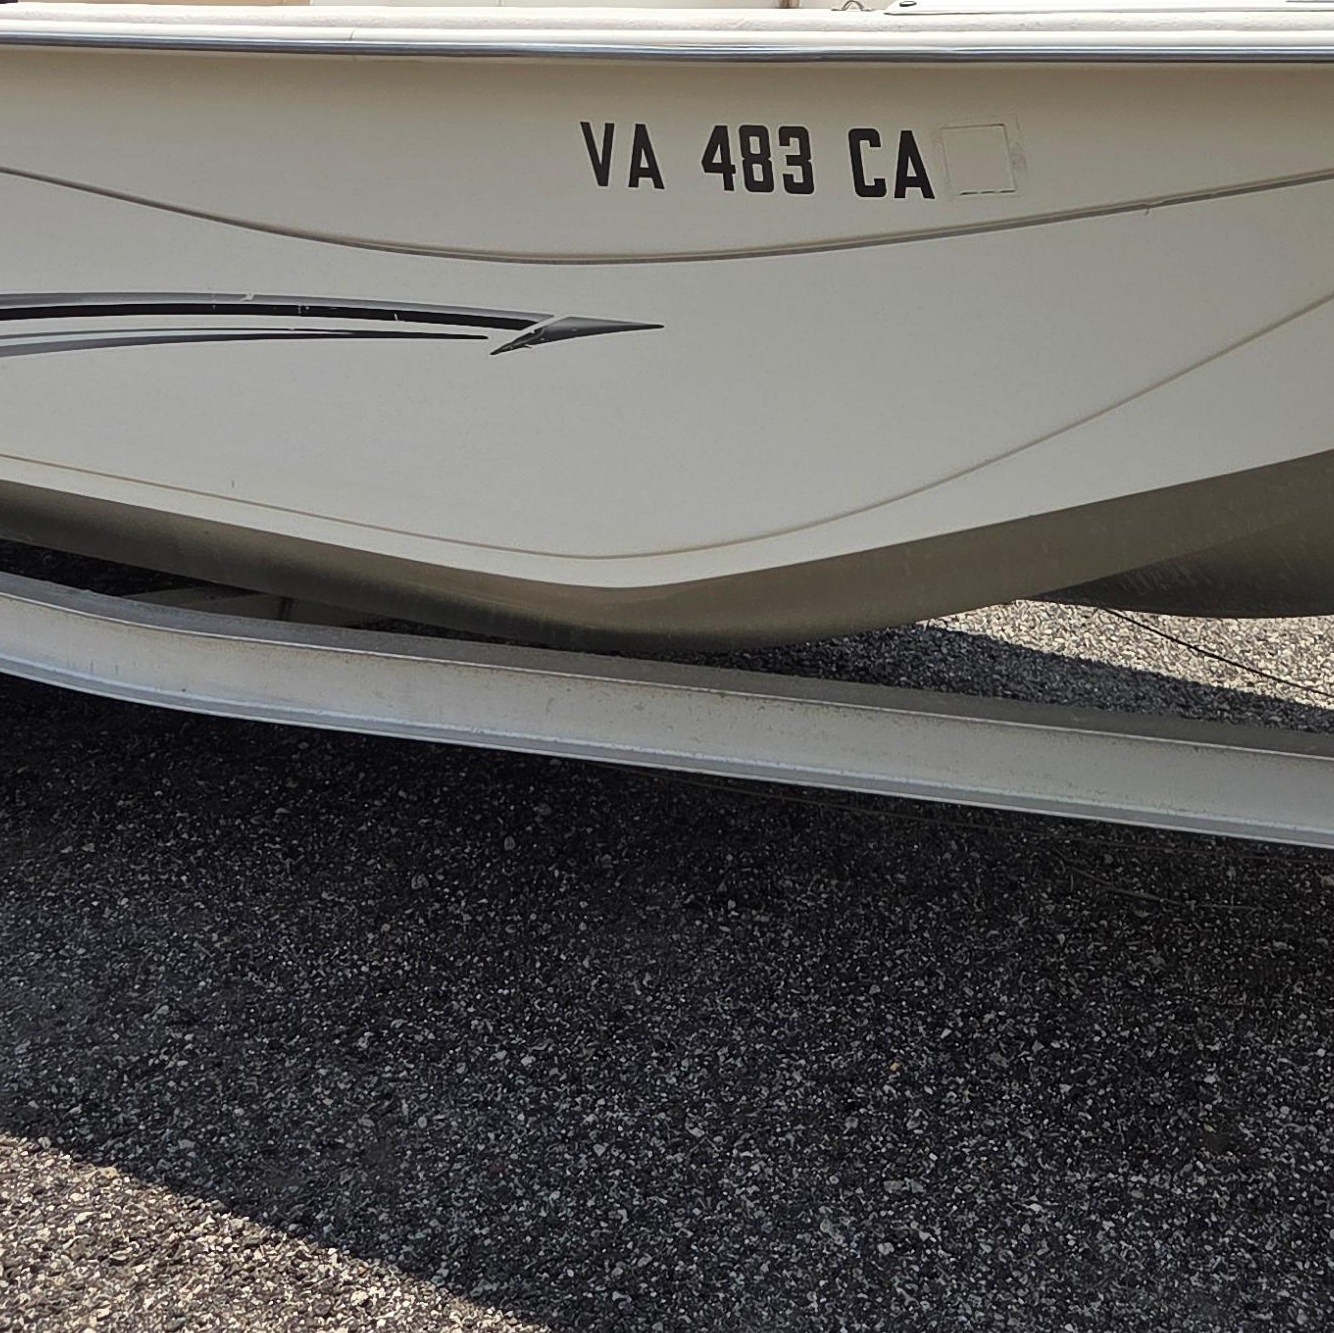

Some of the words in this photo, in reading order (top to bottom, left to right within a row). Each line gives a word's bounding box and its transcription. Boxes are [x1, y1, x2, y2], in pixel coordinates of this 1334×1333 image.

[580, 121, 666, 191] VA
[700, 124, 816, 195] 483
[848, 127, 936, 200] CA
